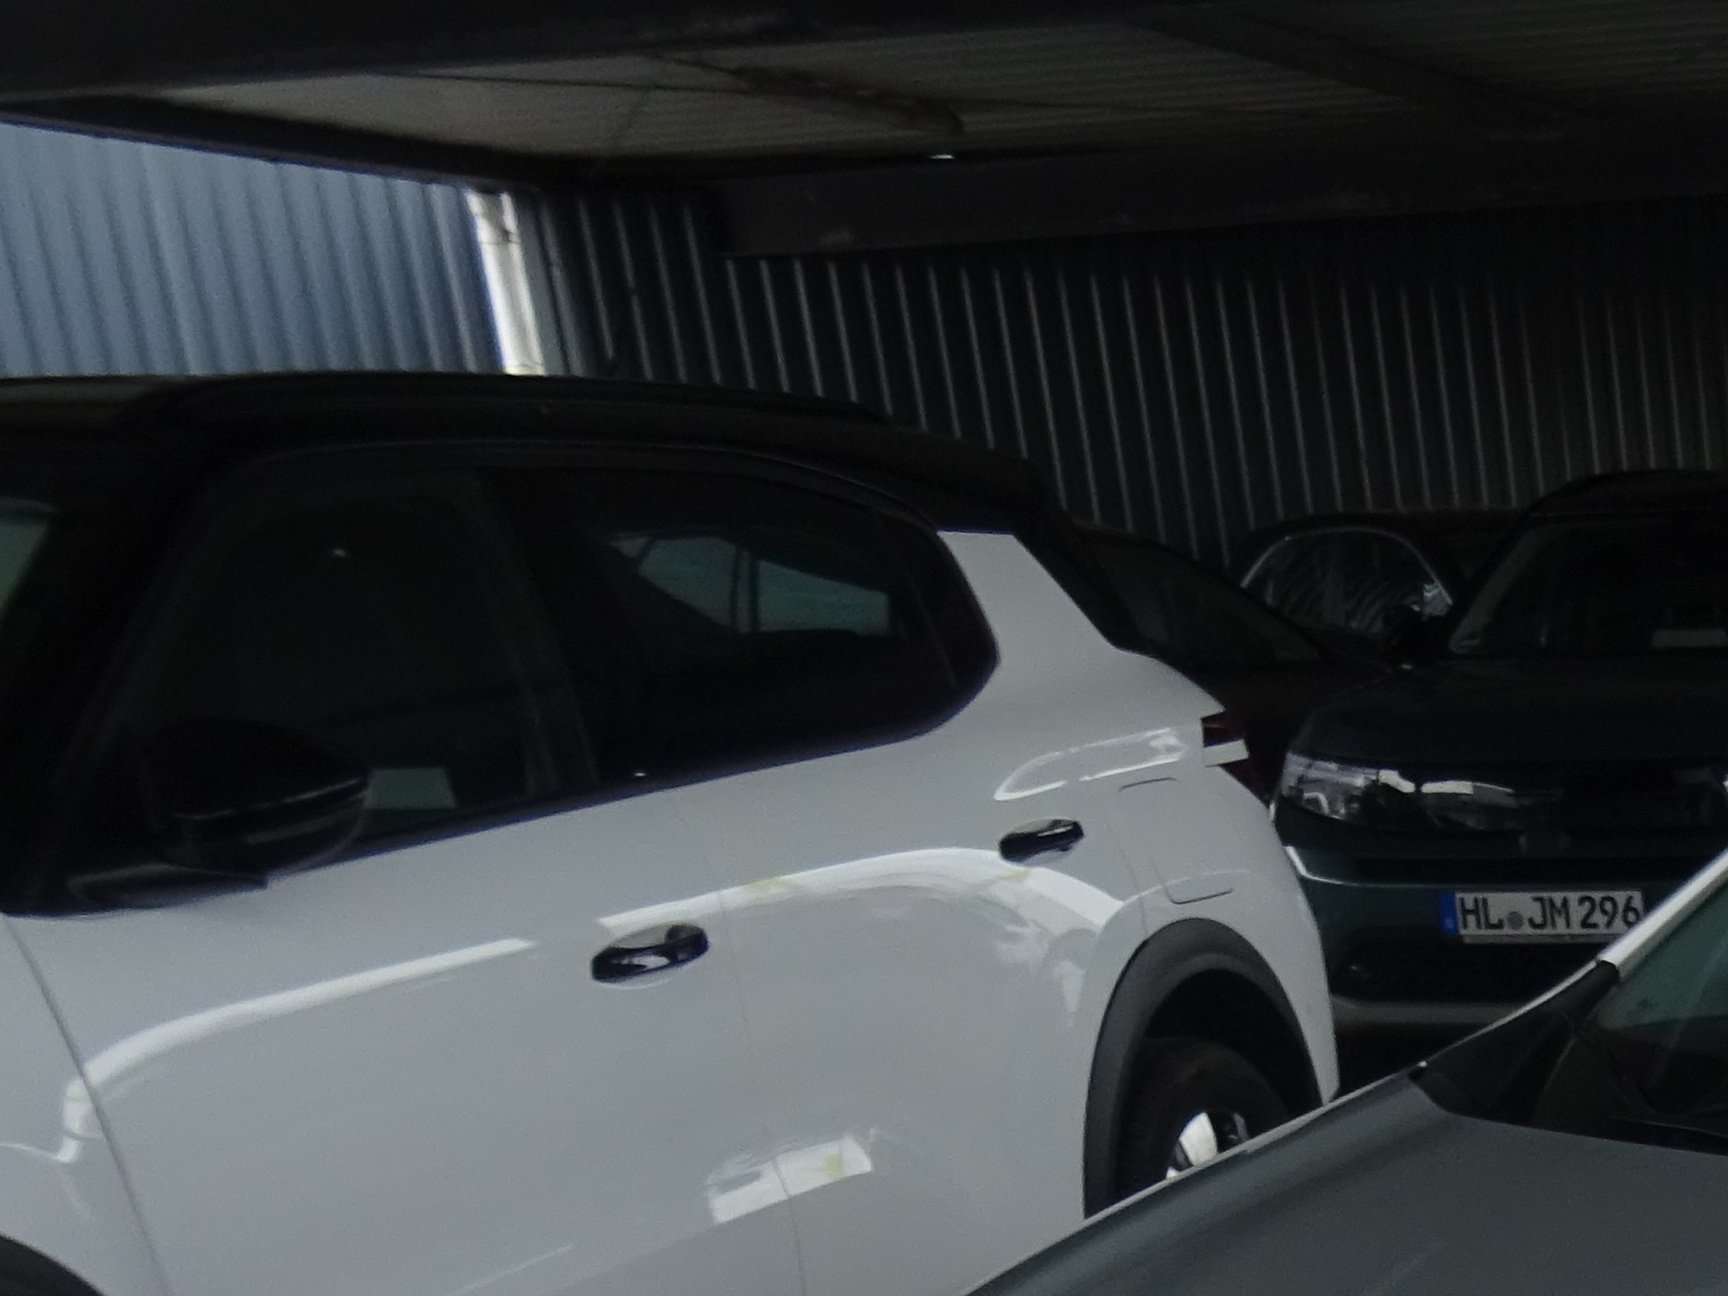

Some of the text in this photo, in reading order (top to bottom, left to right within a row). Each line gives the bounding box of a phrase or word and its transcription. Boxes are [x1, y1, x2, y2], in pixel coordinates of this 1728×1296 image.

[1459, 895, 1640, 930] HL JM 296
